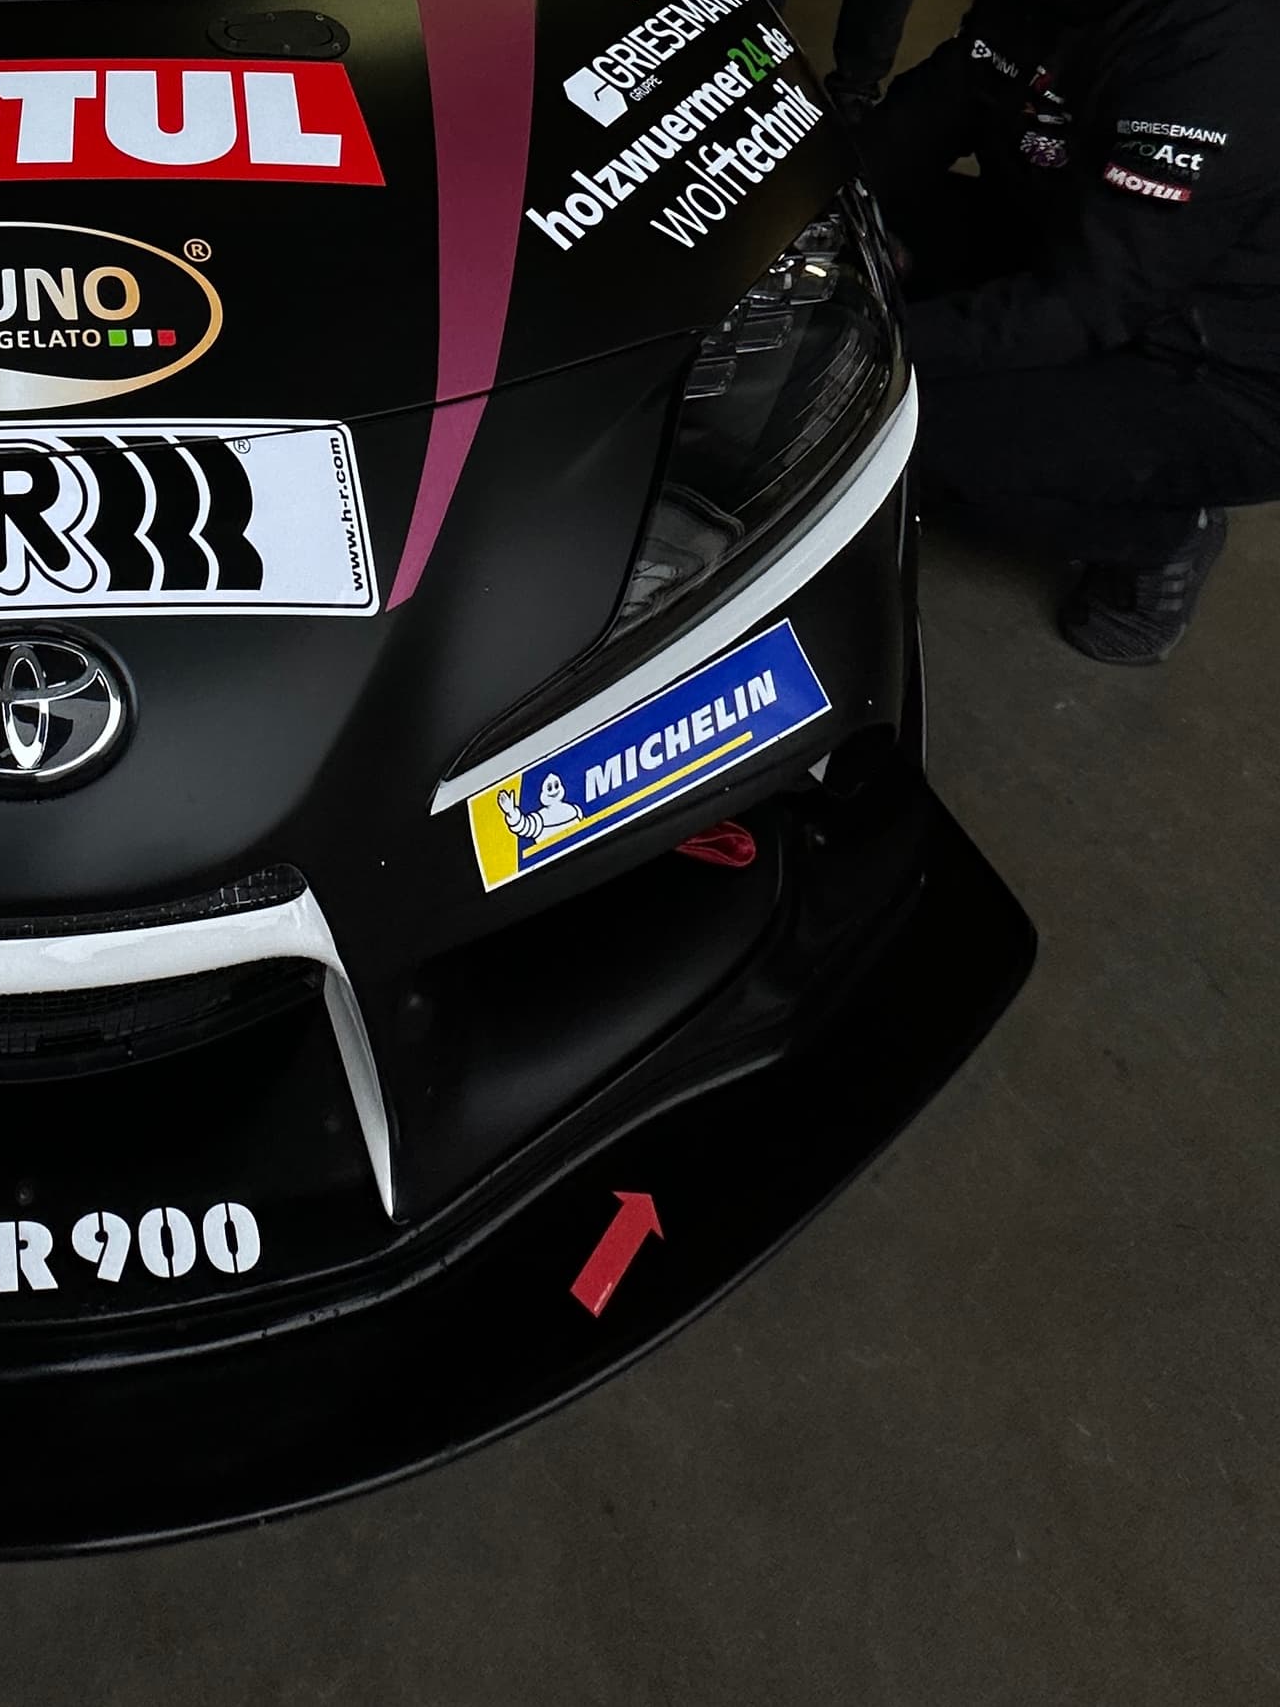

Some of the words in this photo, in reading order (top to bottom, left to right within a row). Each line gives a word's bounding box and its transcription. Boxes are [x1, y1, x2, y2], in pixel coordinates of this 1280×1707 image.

[525, 22, 795, 252] holzwuermer24.de
[1106, 166, 1185, 202] MOTUL
[1130, 120, 1227, 145] GRIESEMANN
[331, 437, 363, 591] www.h-r.com
[584, 669, 778, 803] MICHELIN
[71, 1201, 262, 1283] 900
